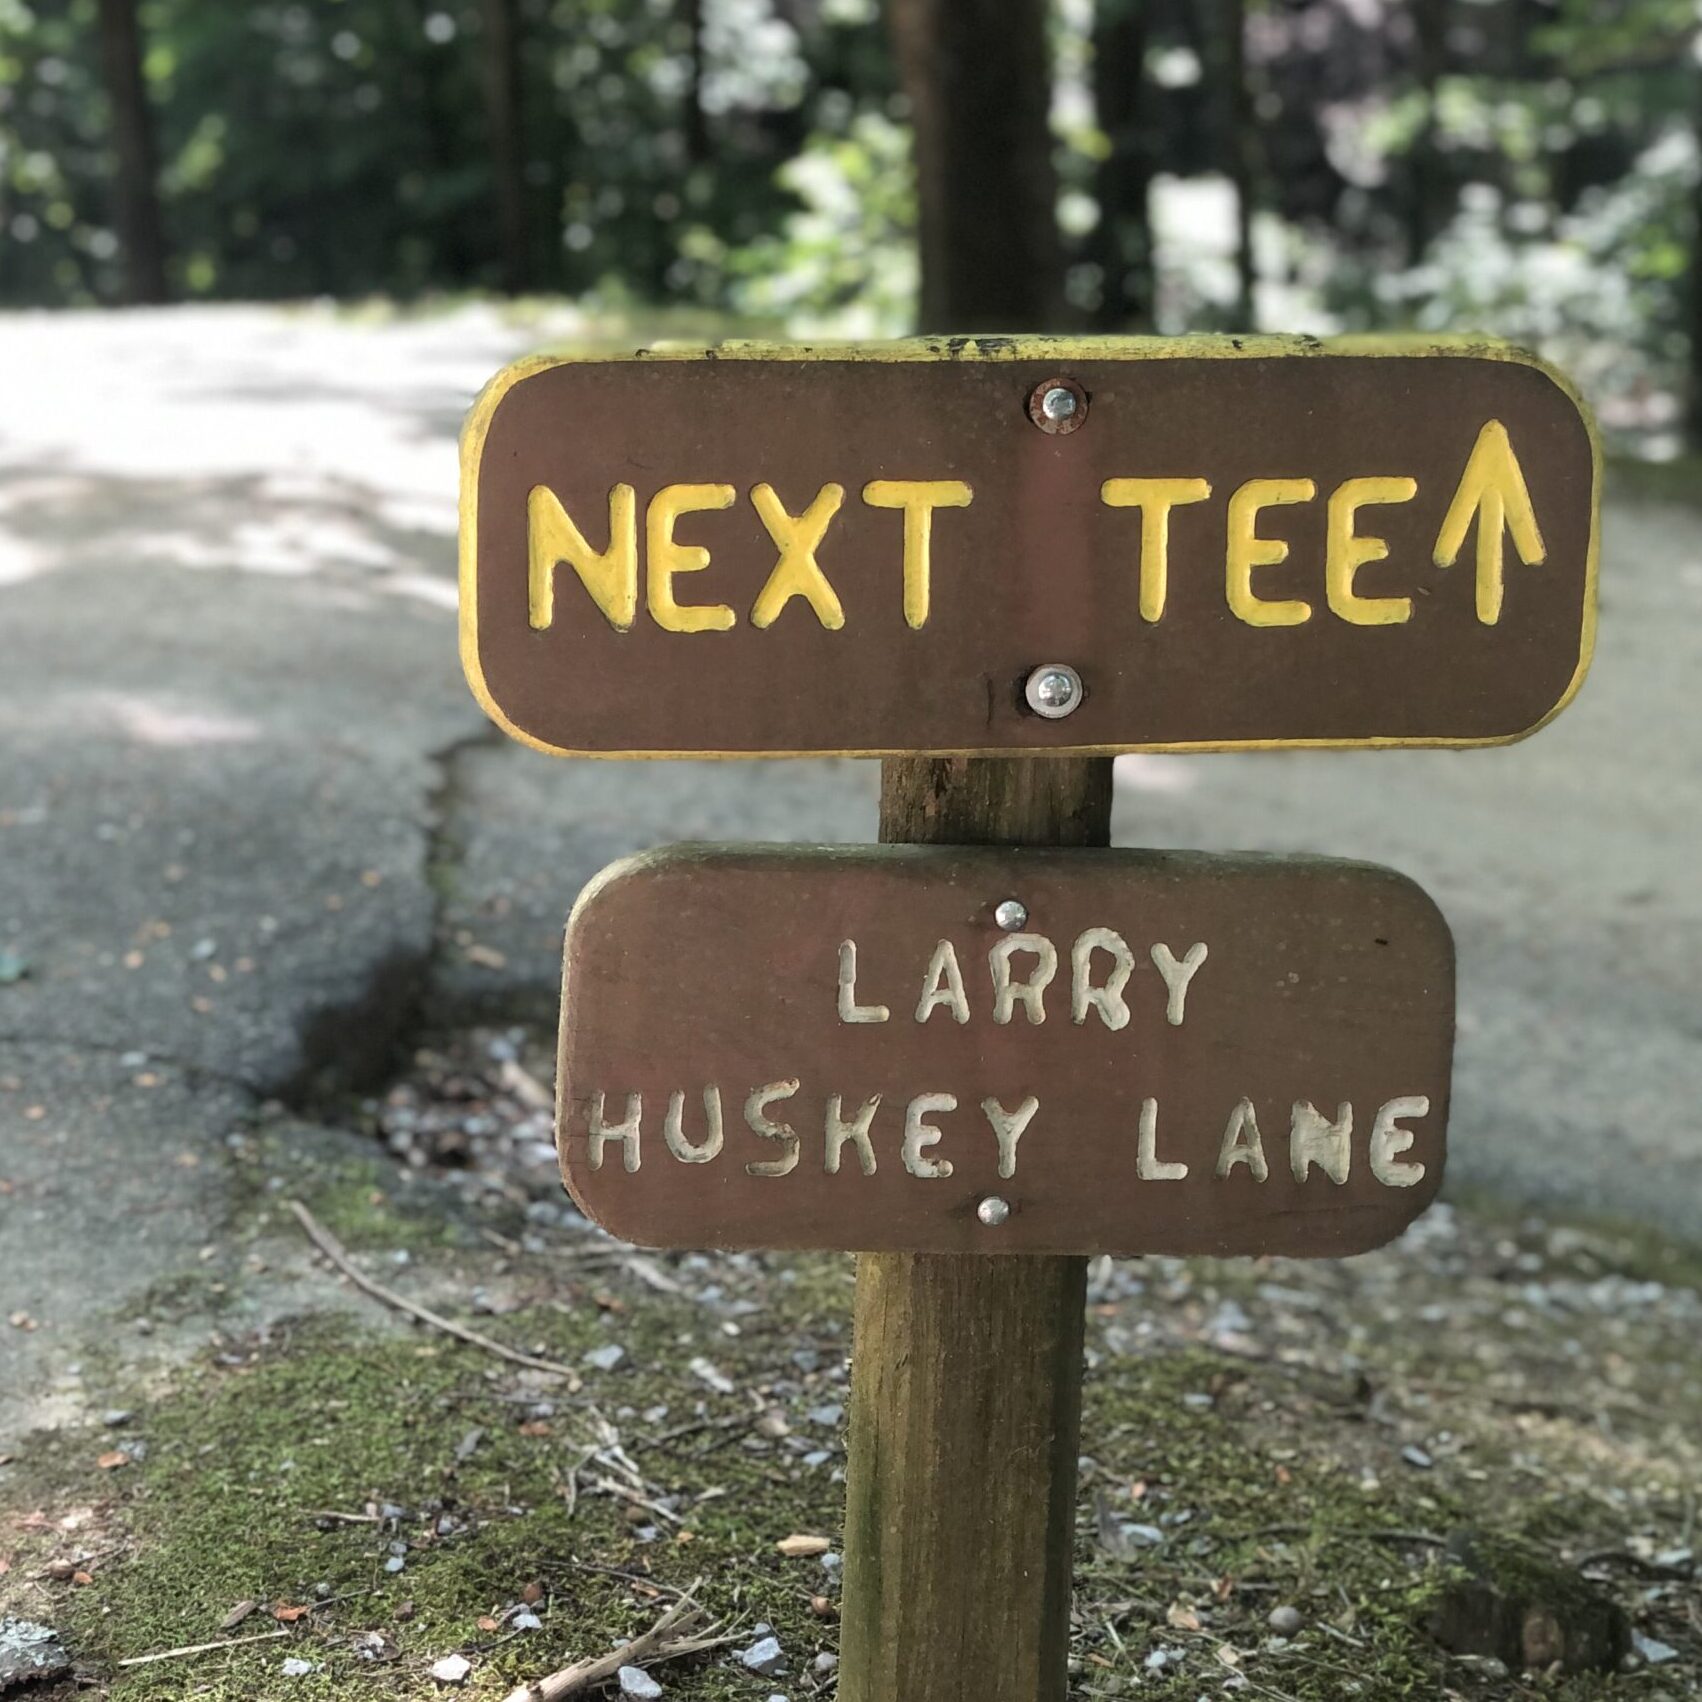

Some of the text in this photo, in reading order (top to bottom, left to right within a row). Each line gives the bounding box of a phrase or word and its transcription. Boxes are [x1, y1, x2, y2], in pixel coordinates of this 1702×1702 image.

[526, 475, 1419, 632] NEXT TEE
[836, 926, 1210, 1033] LARRY
[586, 1079, 1431, 1189] HUSKEY LANE
